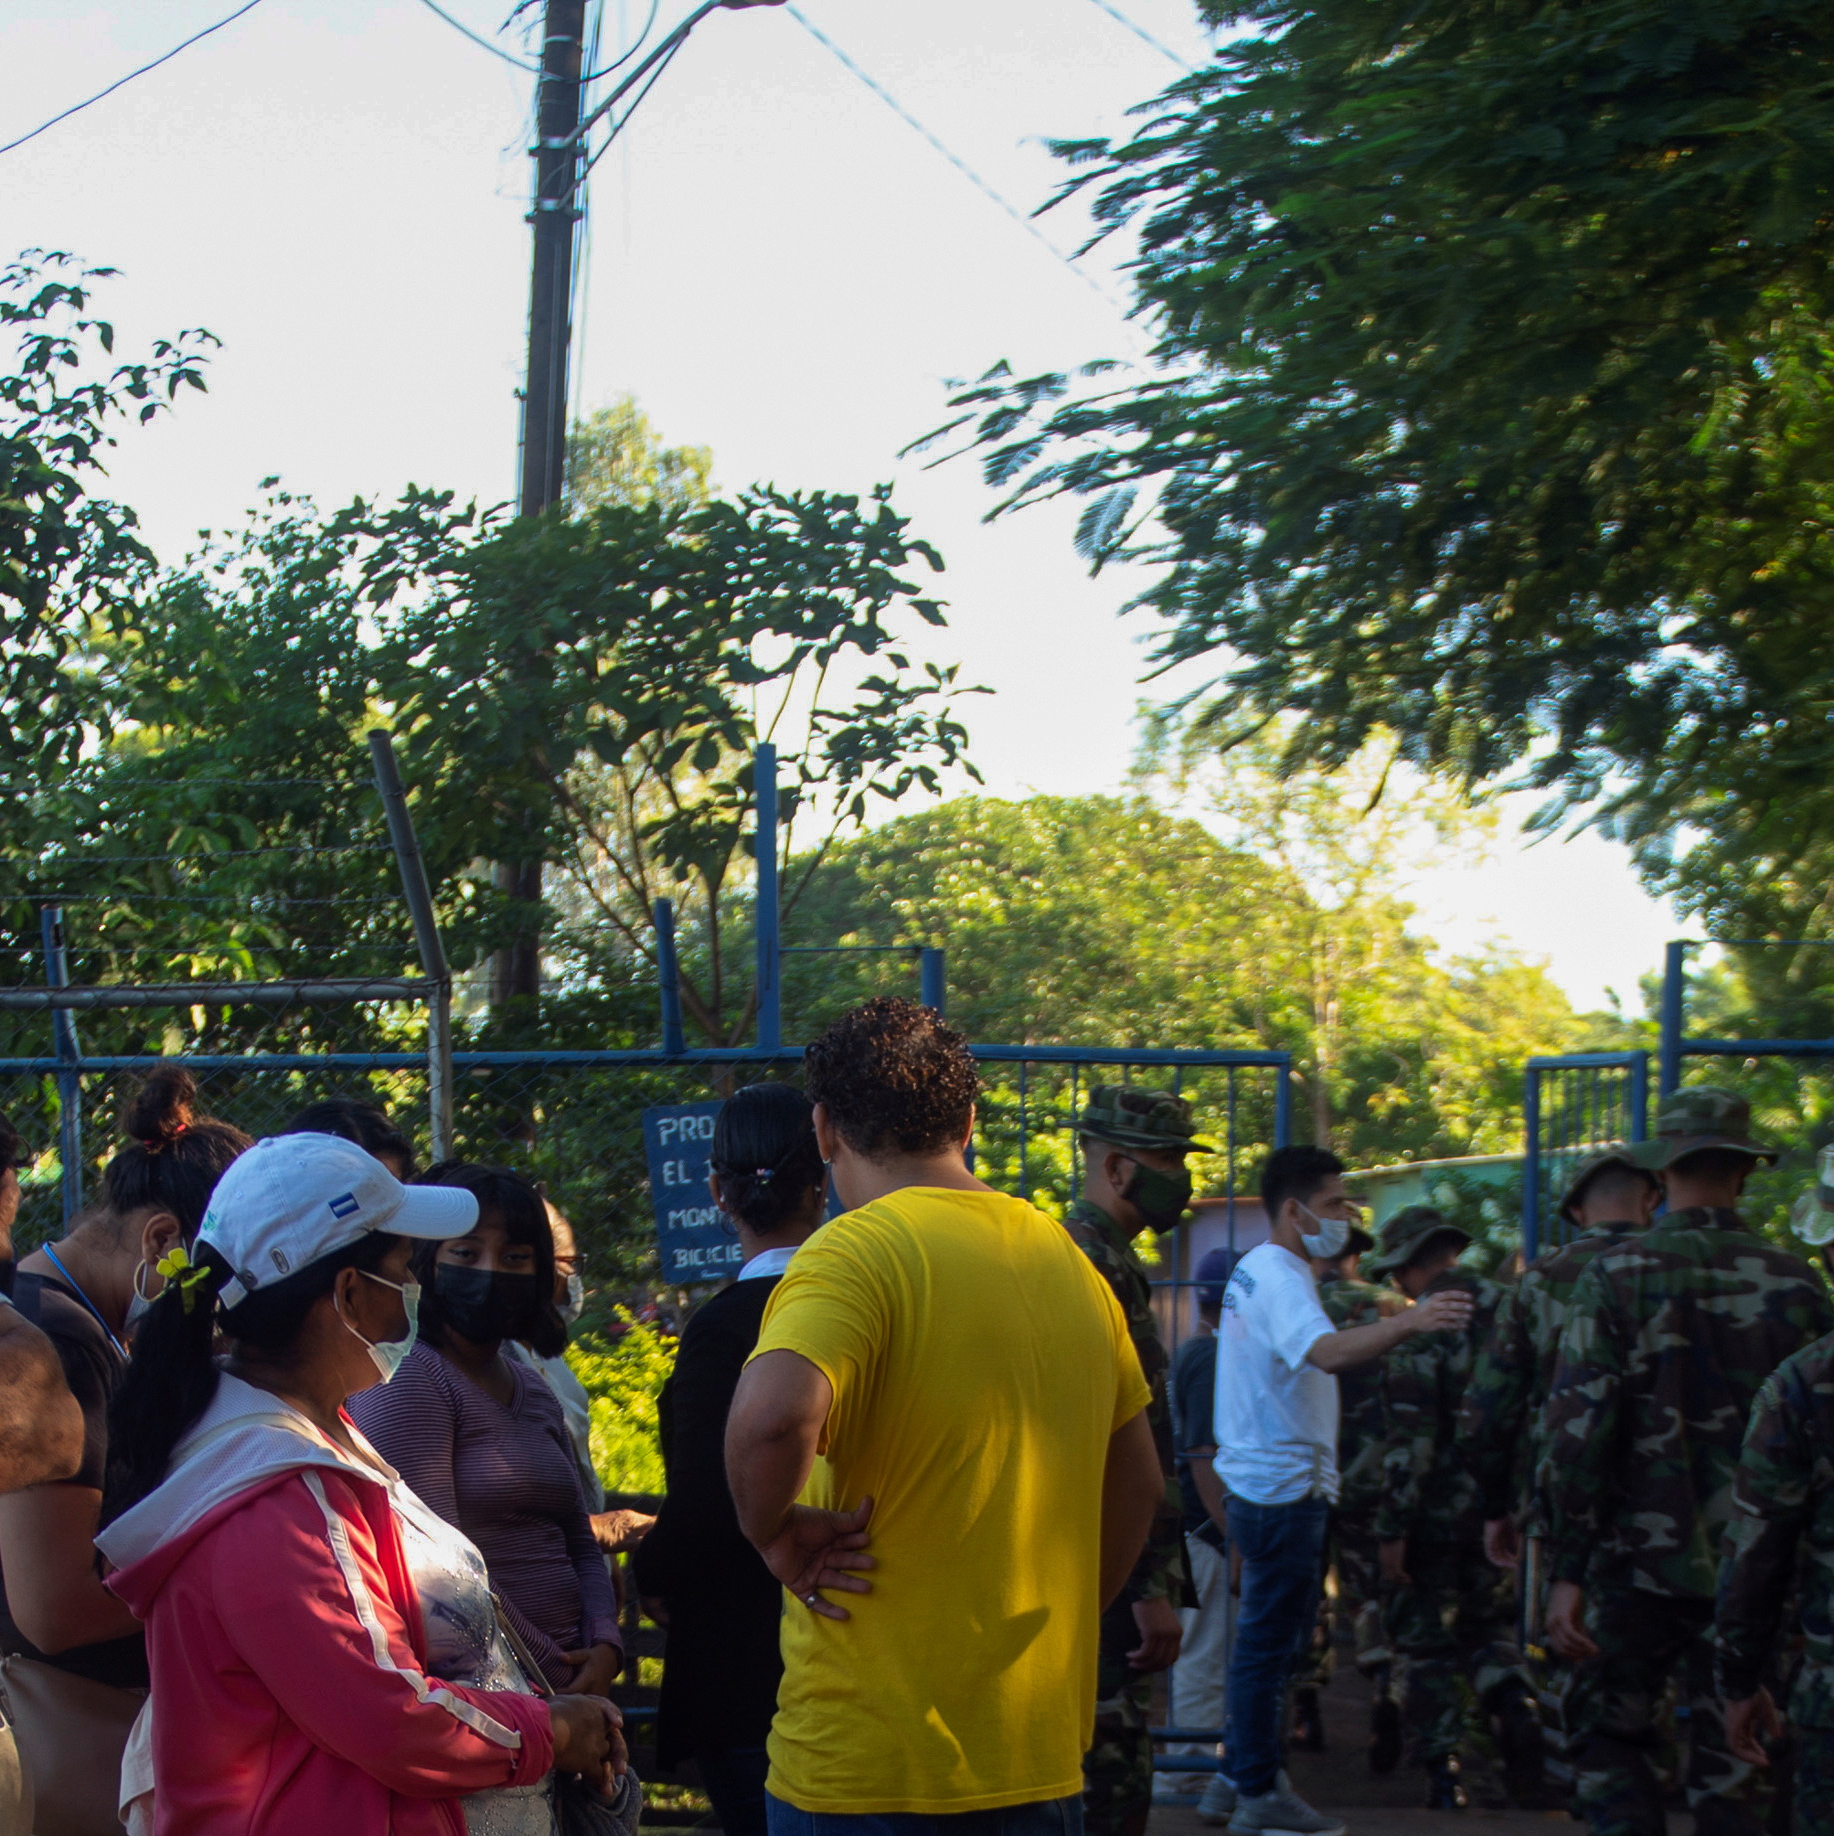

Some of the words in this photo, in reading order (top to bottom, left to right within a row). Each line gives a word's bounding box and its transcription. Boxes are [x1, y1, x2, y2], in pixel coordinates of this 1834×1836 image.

[655, 1115, 717, 1147] PRO
[661, 1158, 692, 1187] EL
[667, 1204, 724, 1231] MONT
[672, 1242, 743, 1269] BICICLE
